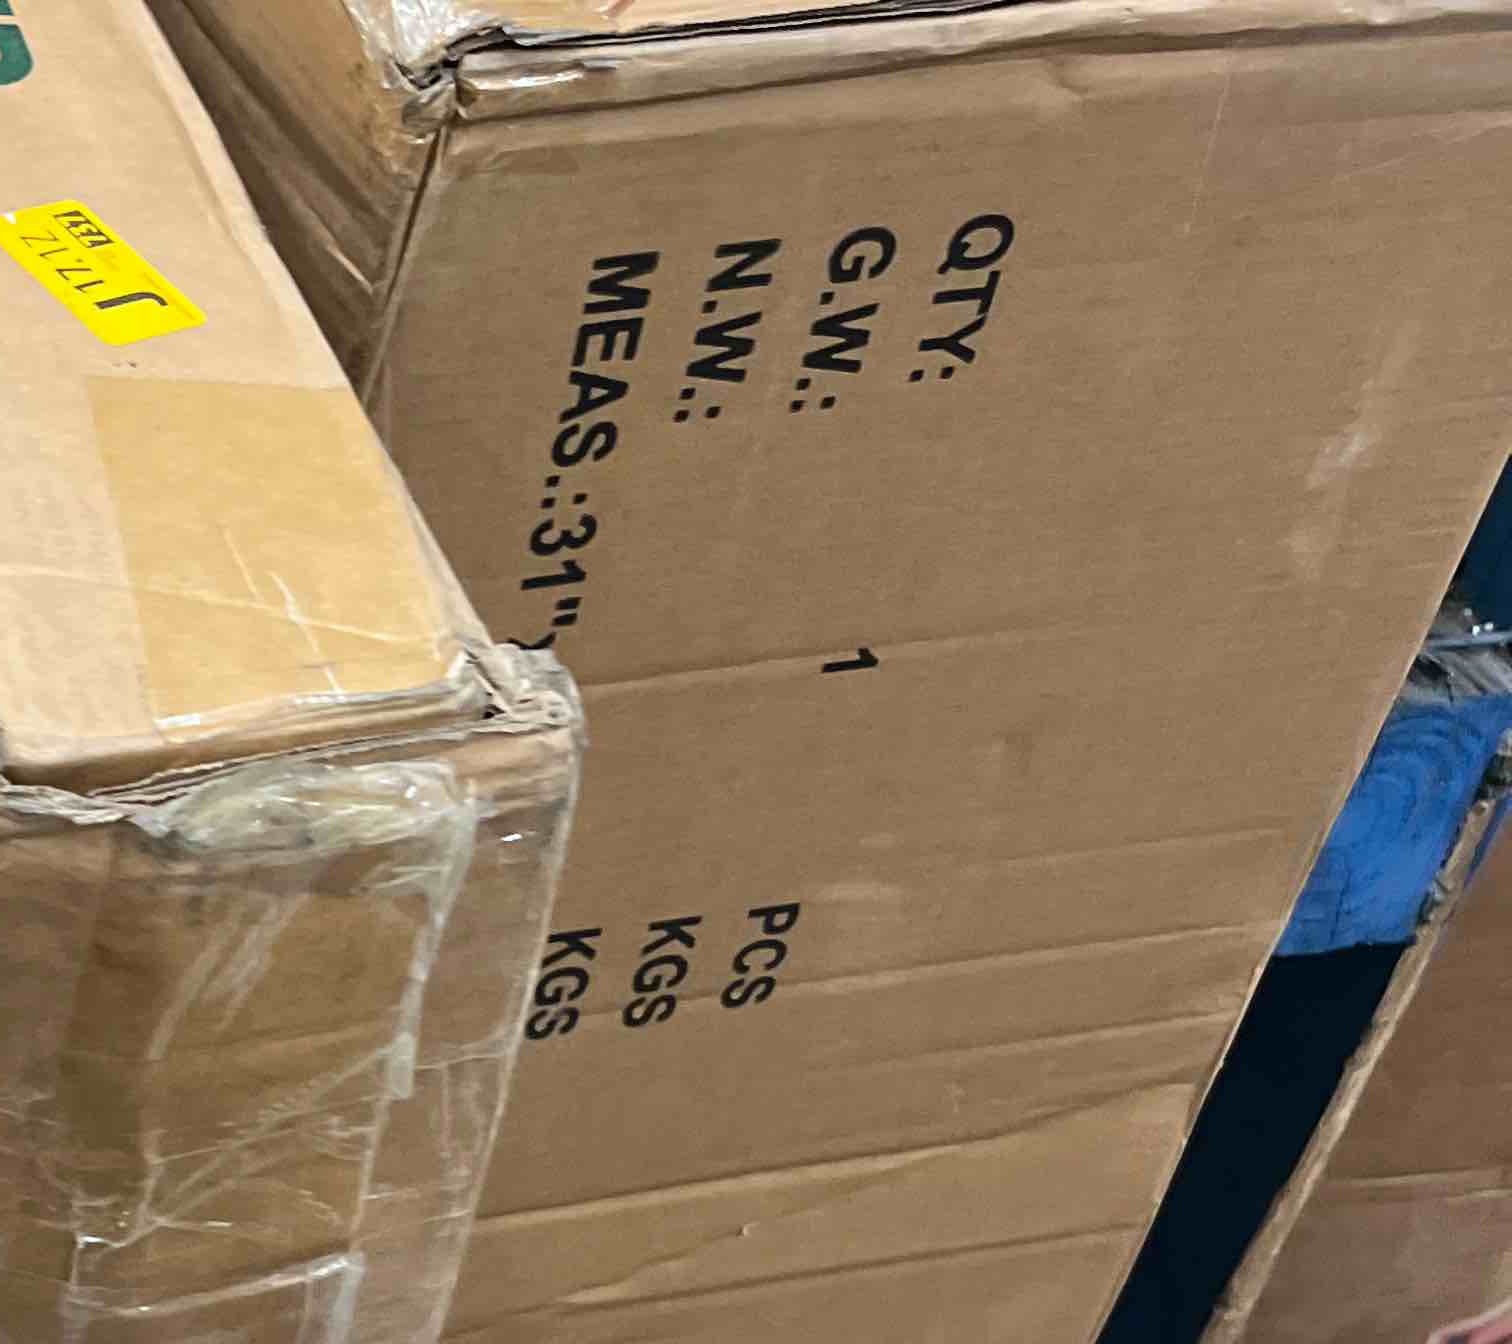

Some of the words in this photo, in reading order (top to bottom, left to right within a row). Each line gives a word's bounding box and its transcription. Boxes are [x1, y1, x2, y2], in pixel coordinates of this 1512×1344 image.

[673, 237, 782, 424] N.W.:
[790, 226, 897, 414] G.W.:
[907, 213, 1015, 383] QTY:
[820, 647, 879, 674] 1
[525, 928, 603, 1041] KGS
[621, 915, 702, 1028] KGS
[719, 902, 801, 1009] PCS
